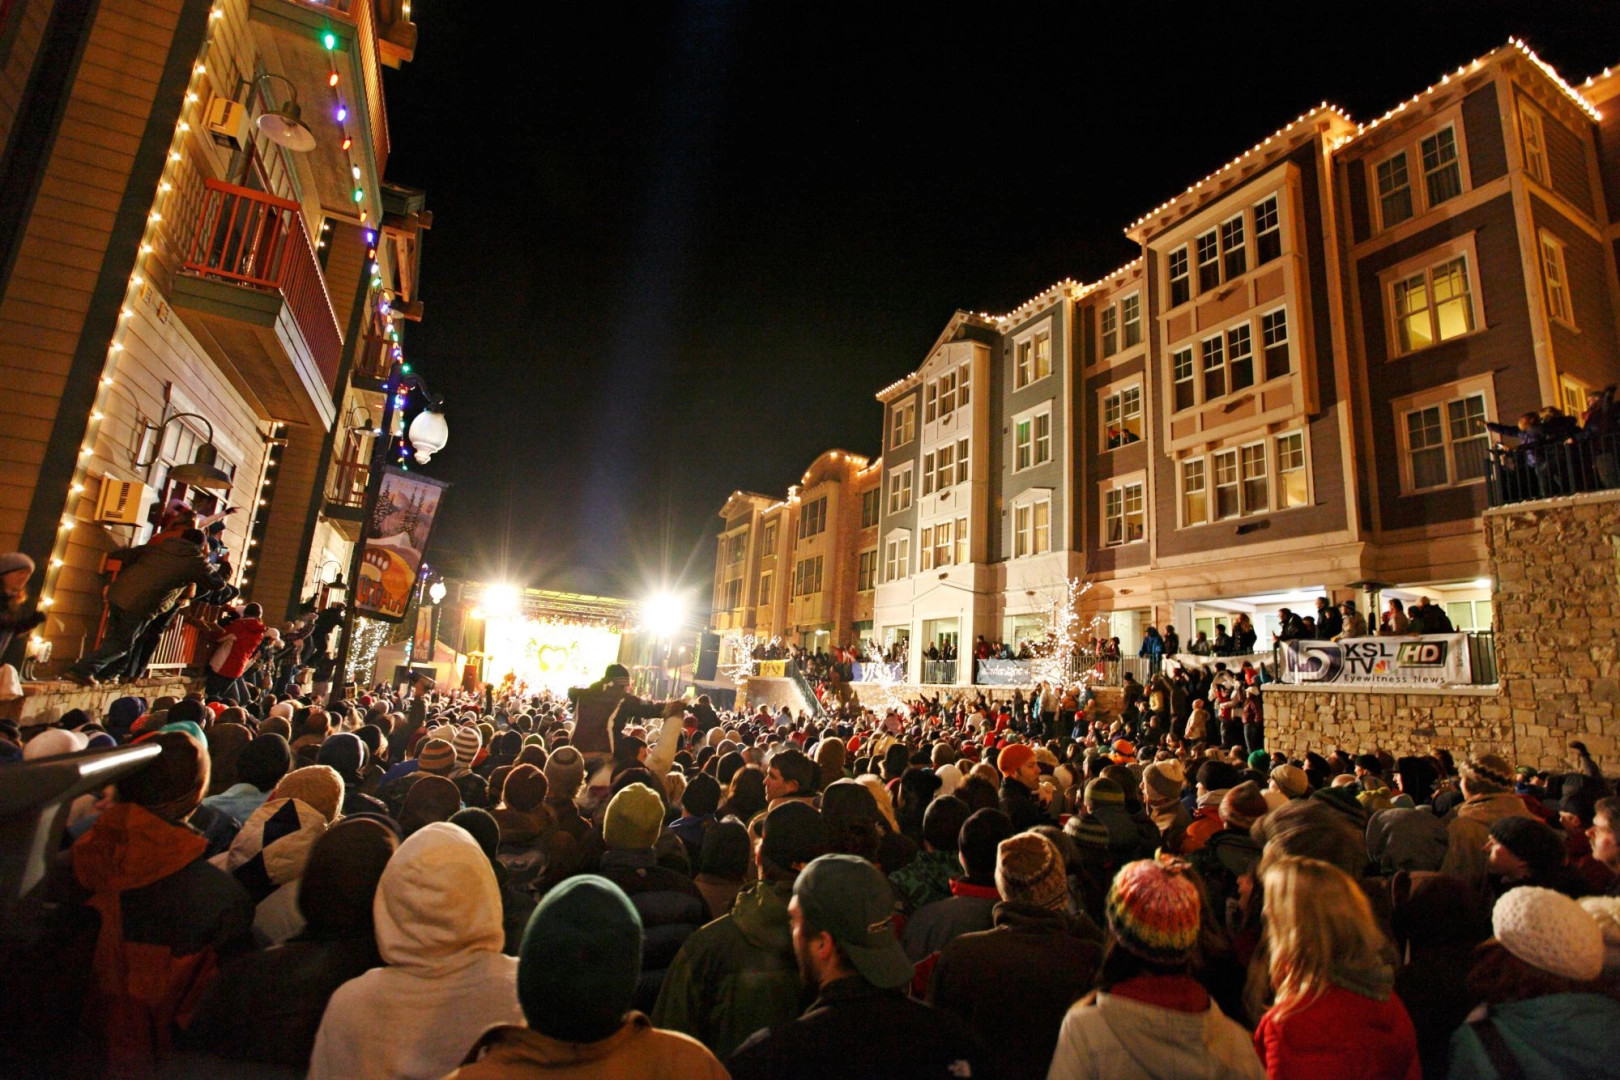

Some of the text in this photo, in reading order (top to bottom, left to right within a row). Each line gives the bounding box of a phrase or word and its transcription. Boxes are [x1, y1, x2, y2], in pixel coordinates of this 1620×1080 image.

[356, 575, 406, 614] UTAH
[1344, 643, 1393, 658] KSL
[1402, 645, 1440, 662] HD
[1290, 640, 1341, 680] 5
[1345, 658, 1375, 674] TV
[1343, 674, 1446, 684] Eyewitness News
